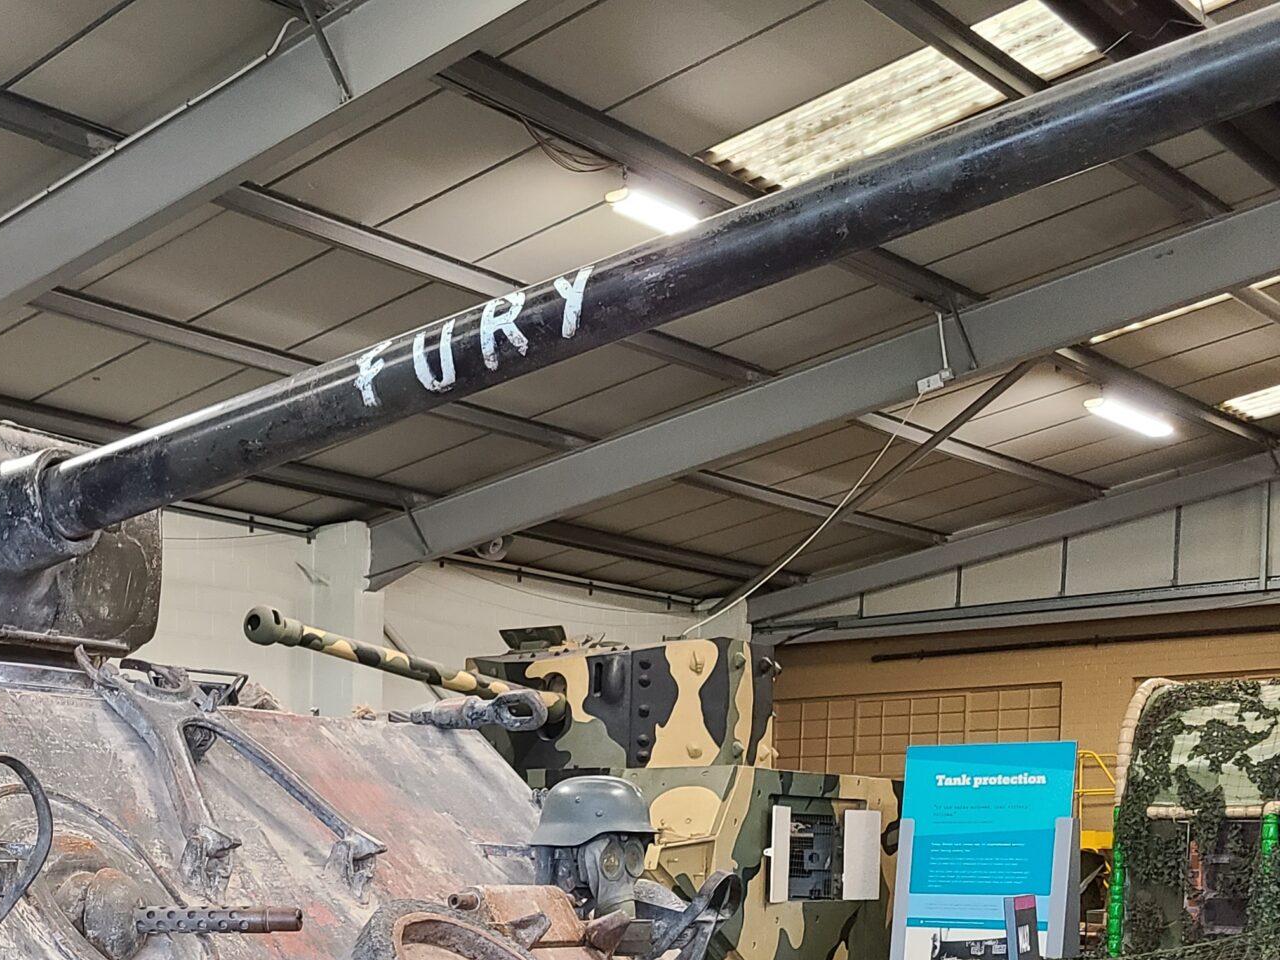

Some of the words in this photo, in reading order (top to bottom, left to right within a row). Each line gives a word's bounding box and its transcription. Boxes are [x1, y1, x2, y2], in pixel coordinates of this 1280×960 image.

[353, 265, 595, 407] FURY
[935, 773, 971, 786] Tank
[972, 772, 1046, 788] protection
